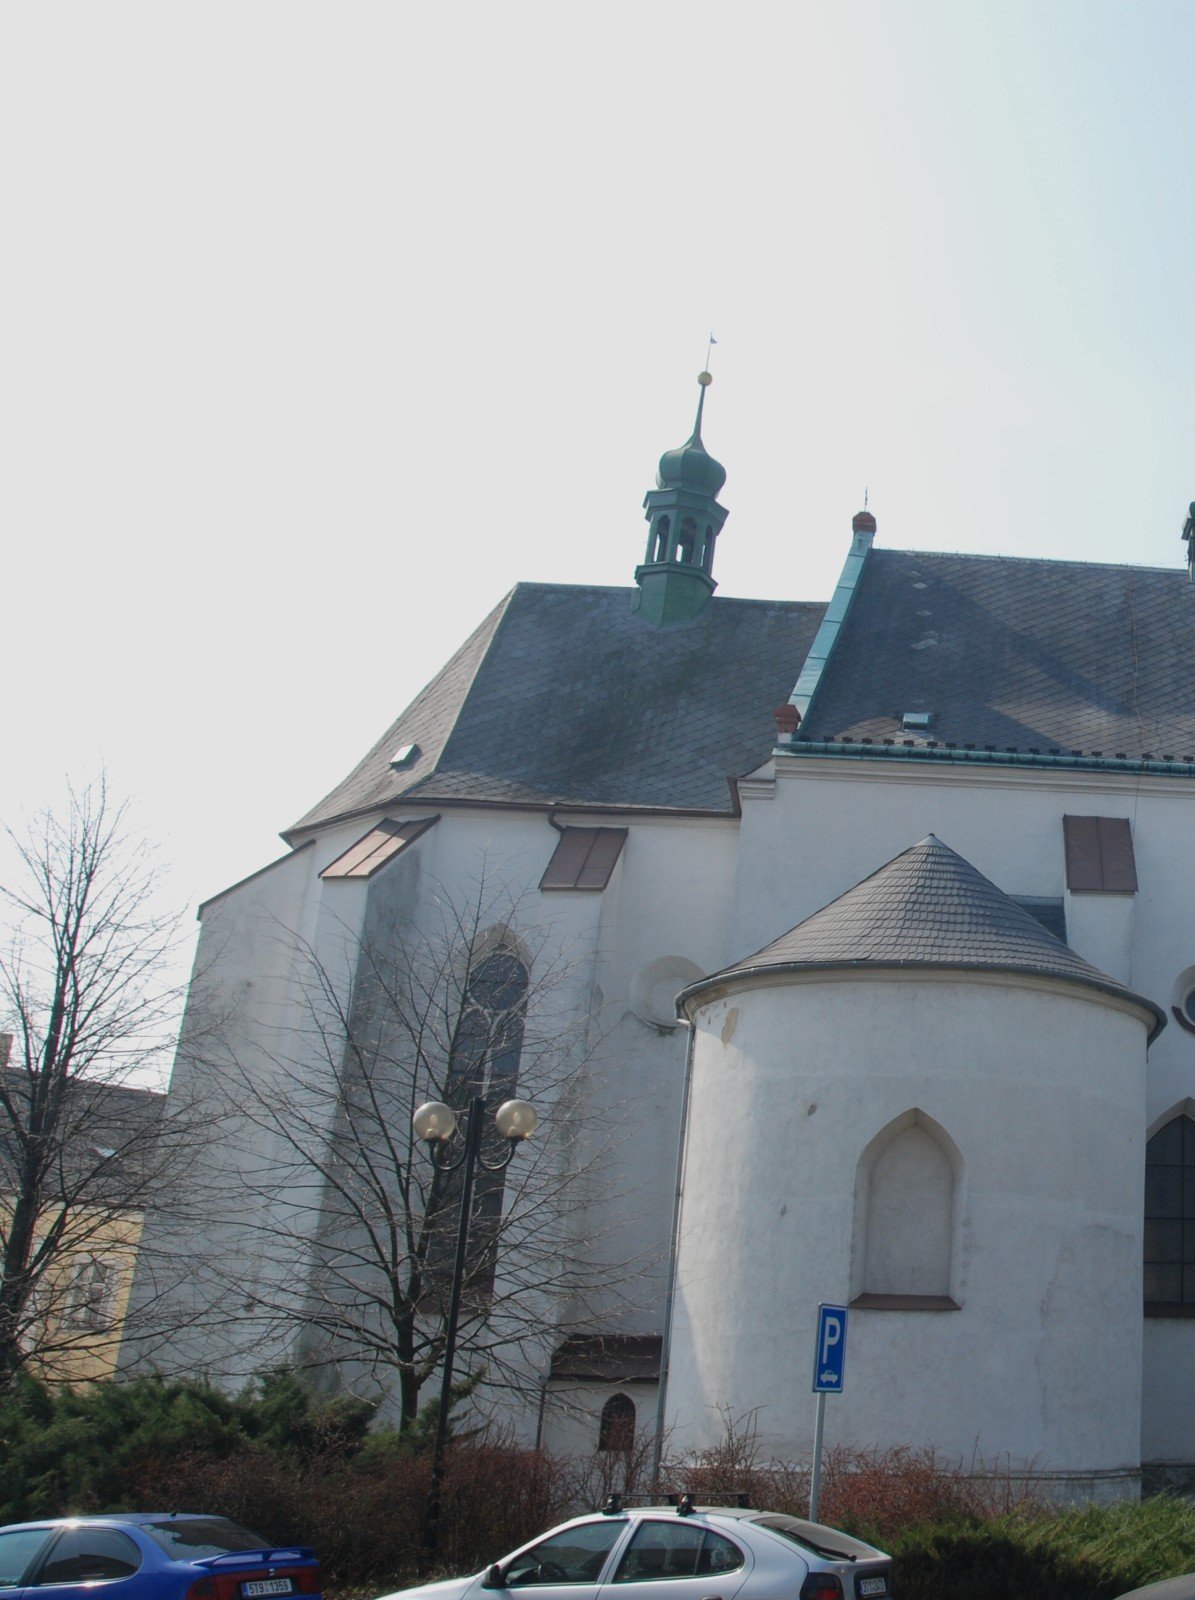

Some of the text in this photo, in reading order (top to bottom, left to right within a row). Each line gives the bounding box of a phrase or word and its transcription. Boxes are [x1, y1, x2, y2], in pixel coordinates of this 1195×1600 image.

[823, 1316, 841, 1364] P
[249, 1580, 289, 1595] 5T9 1359
